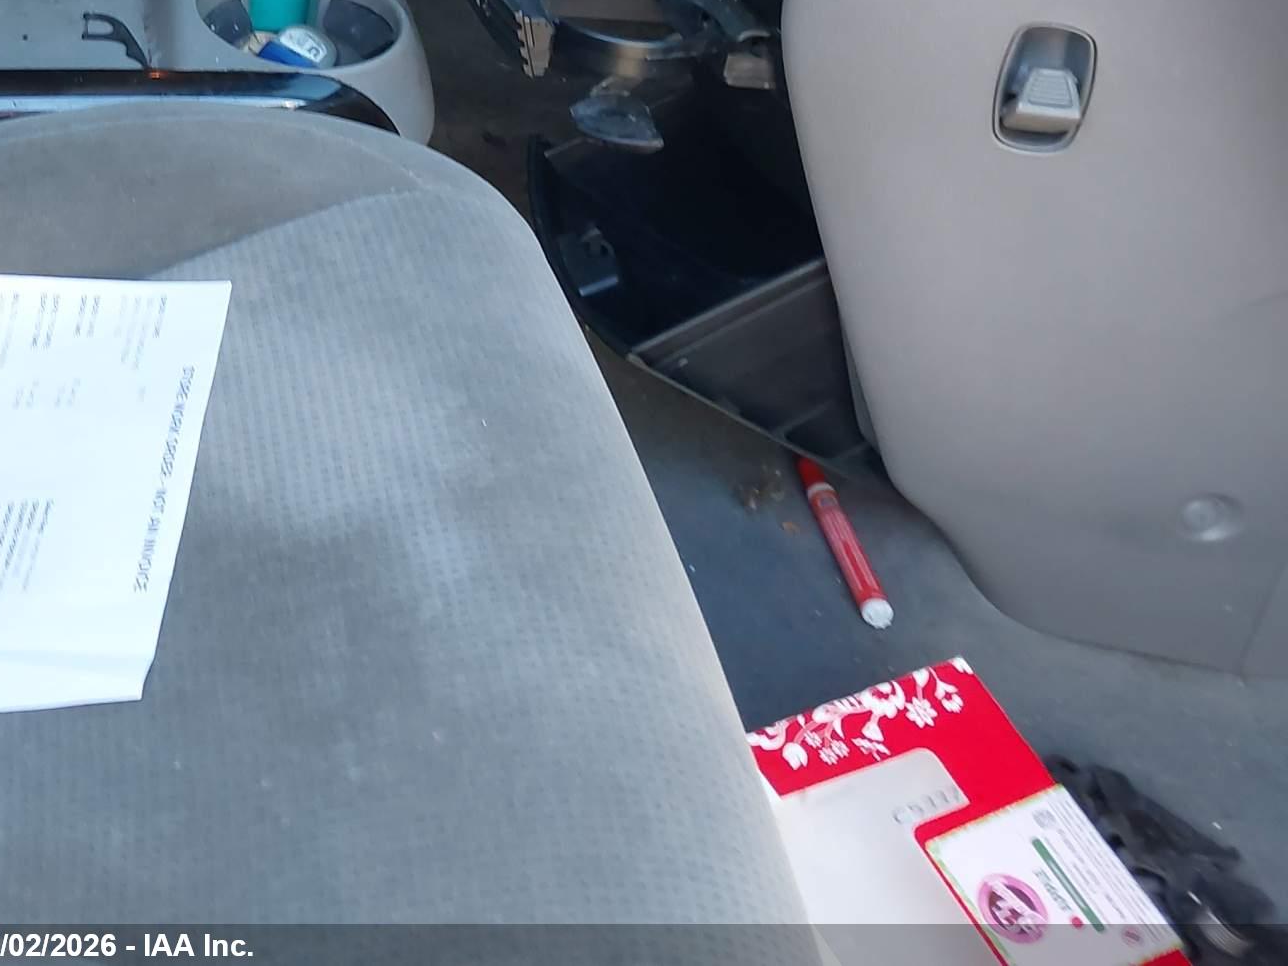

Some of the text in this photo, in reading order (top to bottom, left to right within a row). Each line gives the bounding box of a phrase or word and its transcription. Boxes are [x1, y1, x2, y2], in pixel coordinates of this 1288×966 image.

[160, 437, 180, 478] ORDER
[152, 487, 168, 514] NOT
[148, 515, 162, 534] AN
[132, 538, 157, 594] INVOICE
